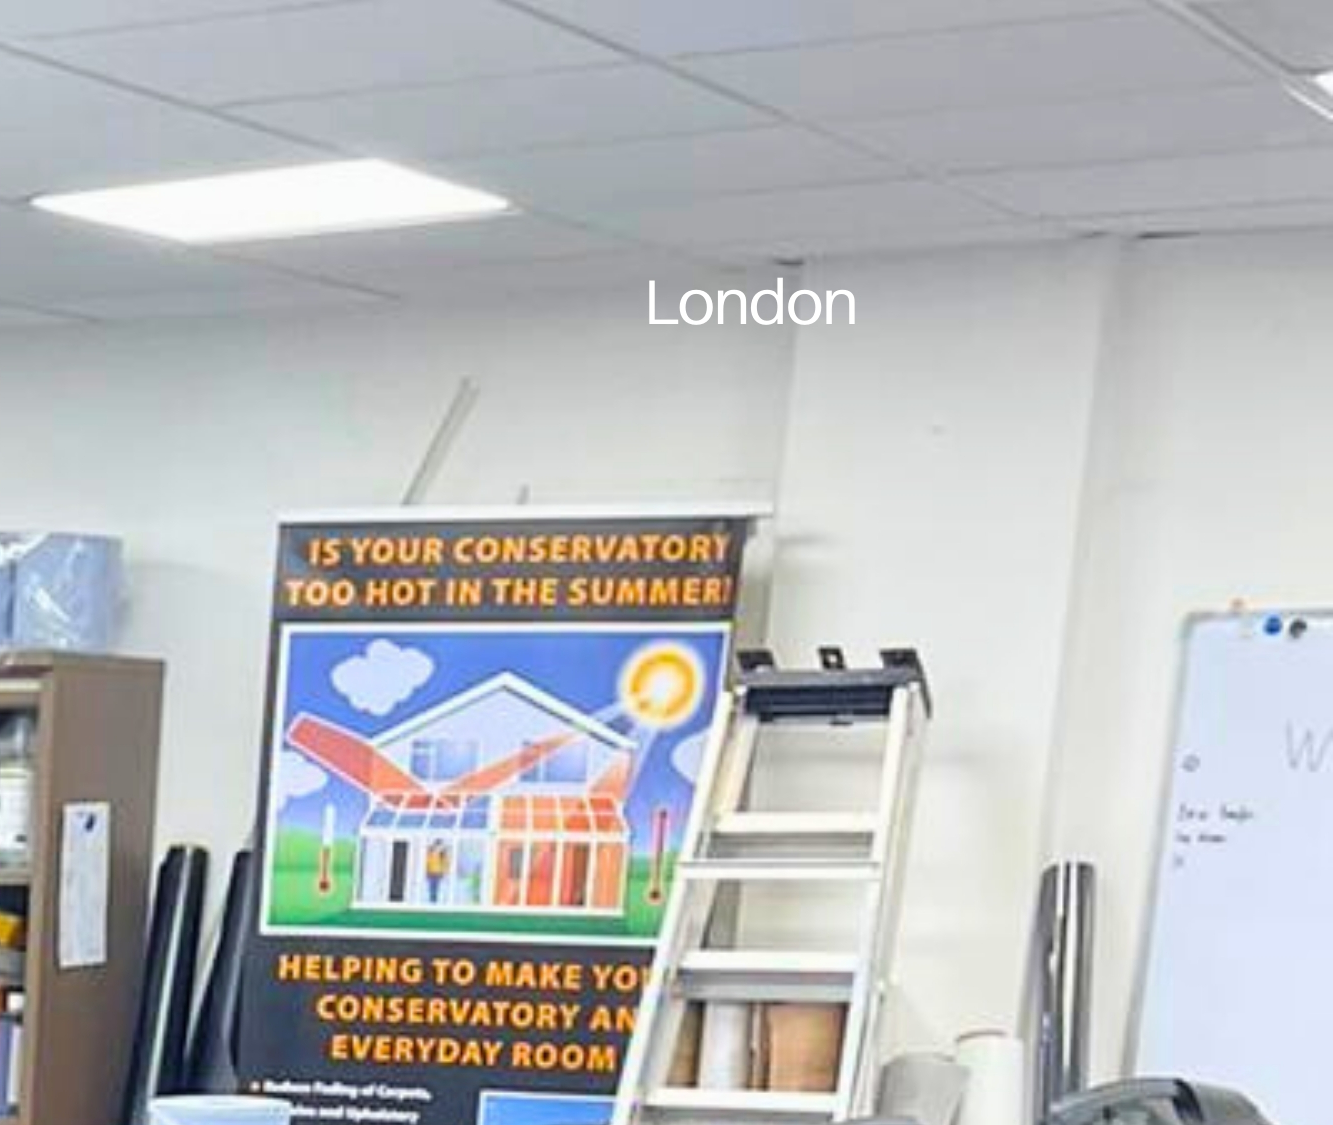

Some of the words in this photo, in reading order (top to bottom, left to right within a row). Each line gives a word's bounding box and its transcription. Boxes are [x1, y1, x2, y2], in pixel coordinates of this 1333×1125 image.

[308, 538, 340, 565] IS
[350, 537, 444, 565] YOUR
[452, 533, 730, 564] CONSERVATORY
[286, 579, 354, 607] TOO
[365, 579, 436, 607] HOT
[446, 578, 482, 607] IN
[491, 577, 558, 606] THE
[278, 954, 422, 985] HELPING
[433, 957, 476, 987] TO
[485, 960, 582, 990] MAKE
[316, 995, 580, 1031] CONSERVATORY
[329, 1035, 504, 1068] EVERYDAY
[512, 1043, 617, 1072] ROOM
